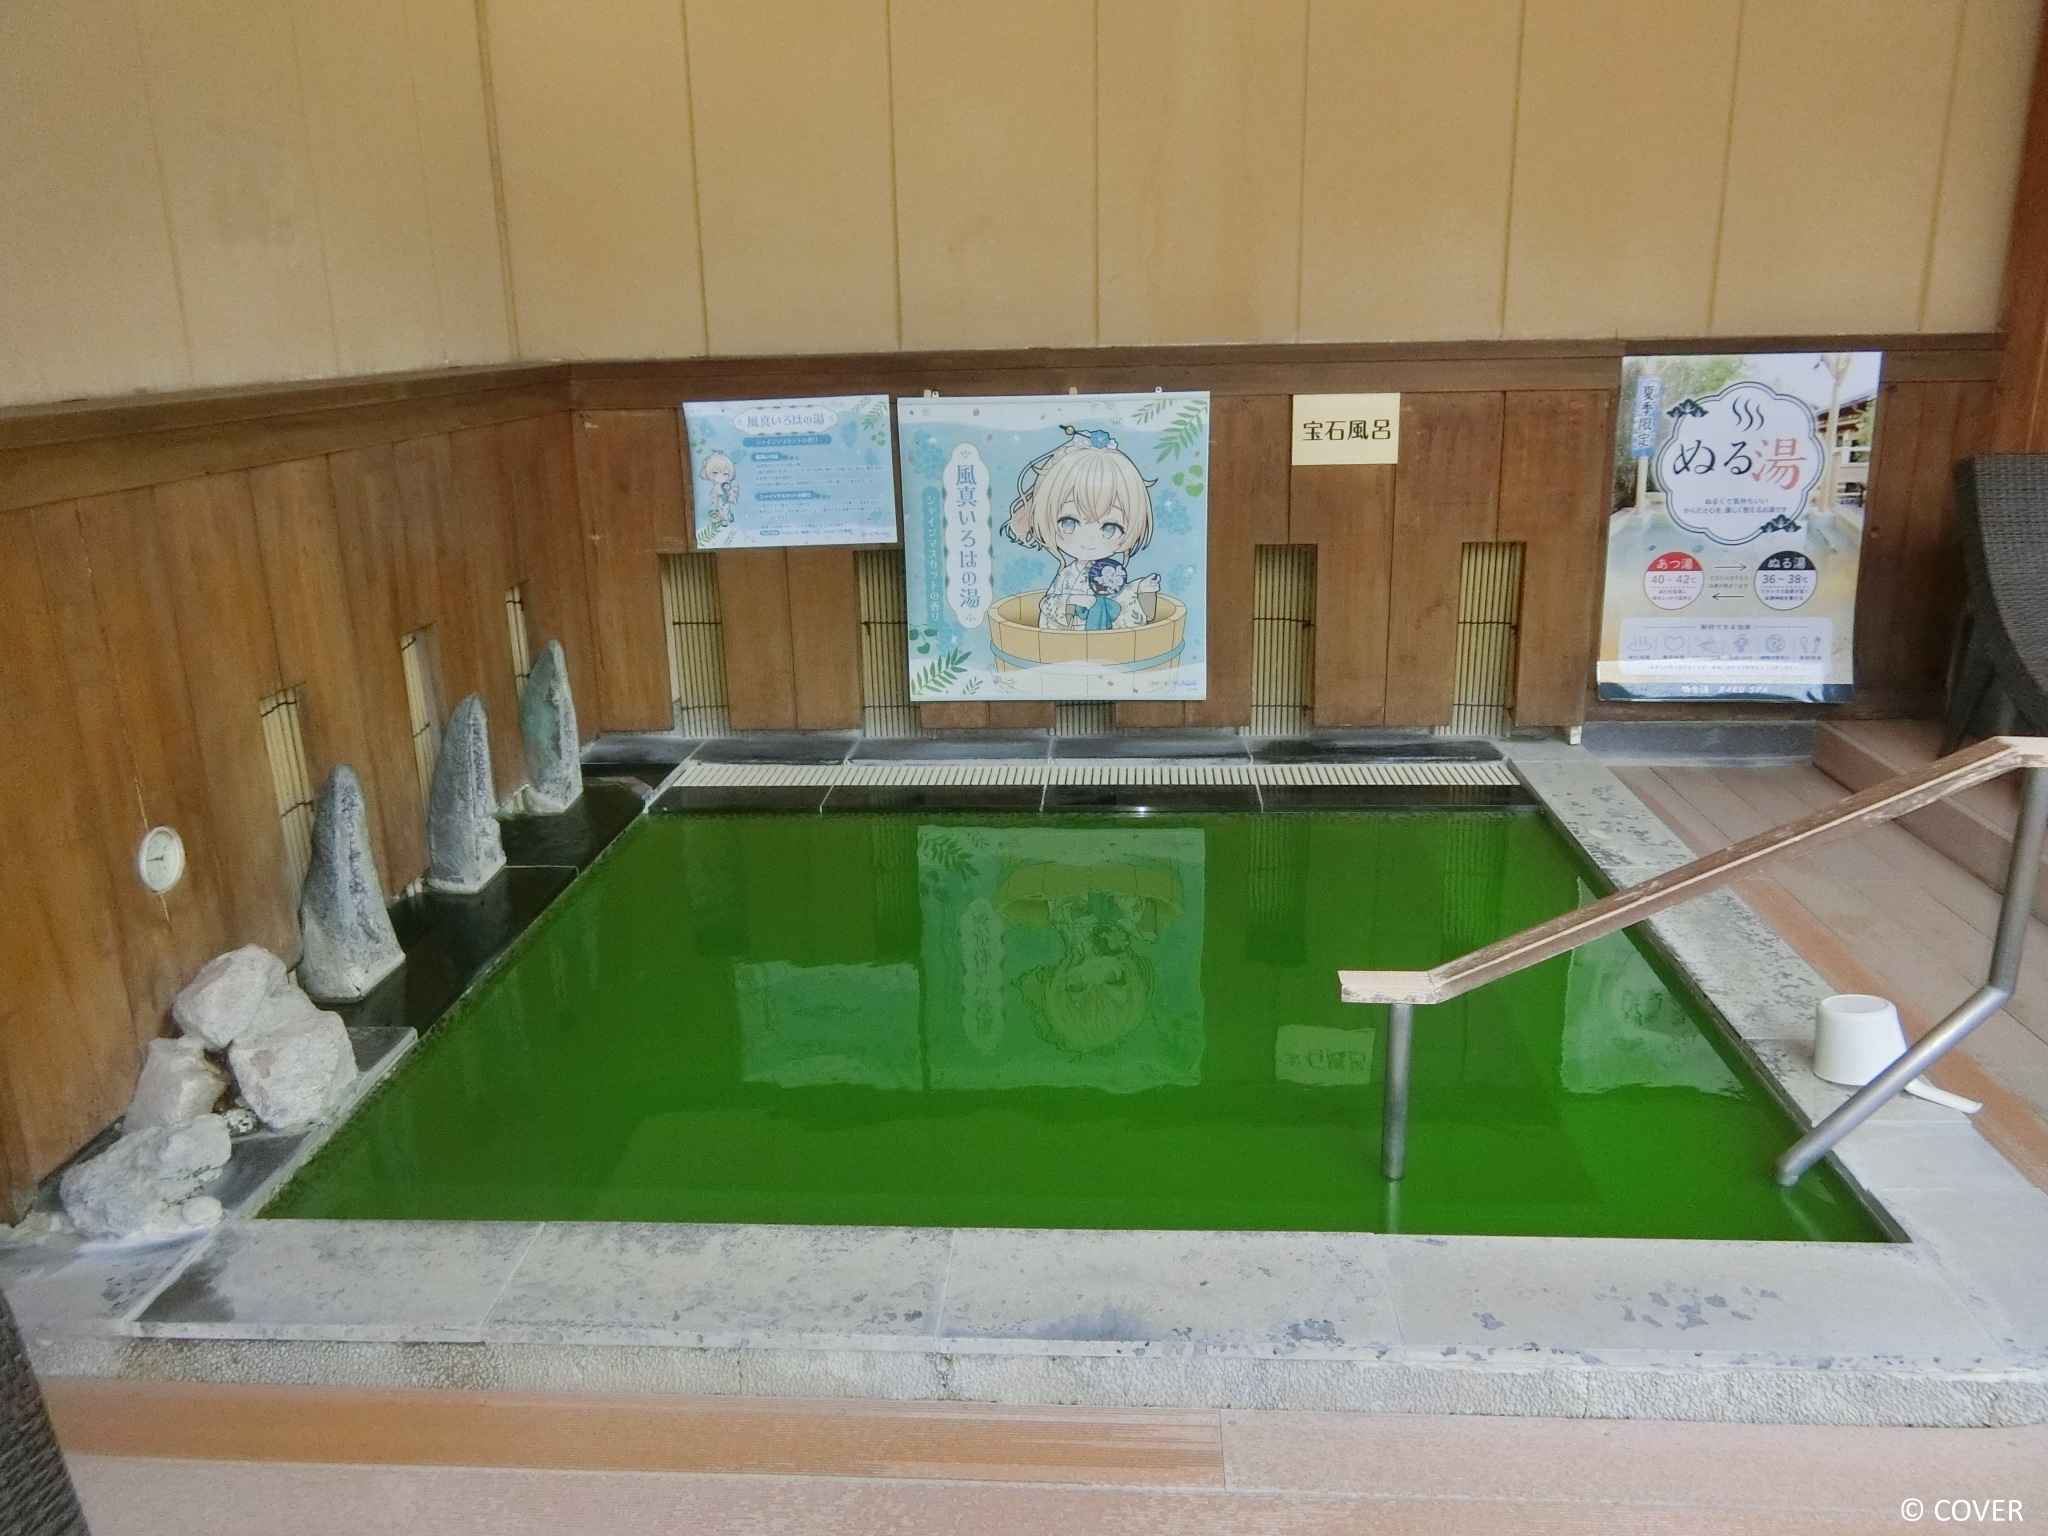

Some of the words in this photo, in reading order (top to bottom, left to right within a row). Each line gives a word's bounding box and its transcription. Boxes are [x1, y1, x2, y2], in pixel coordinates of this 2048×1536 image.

[747, 413, 825, 428] 風真いろはの湯
[1302, 419, 1392, 443] 宝石風呂
[1637, 384, 1655, 447] 夏季限定
[1673, 437, 1807, 490] ぬる湯
[955, 464, 981, 609] 風真いろはの湯
[927, 496, 941, 621] シャインマスカットの香り
[1656, 557, 1694, 570] あつ湯
[1767, 557, 1806, 569] ぬる湯
